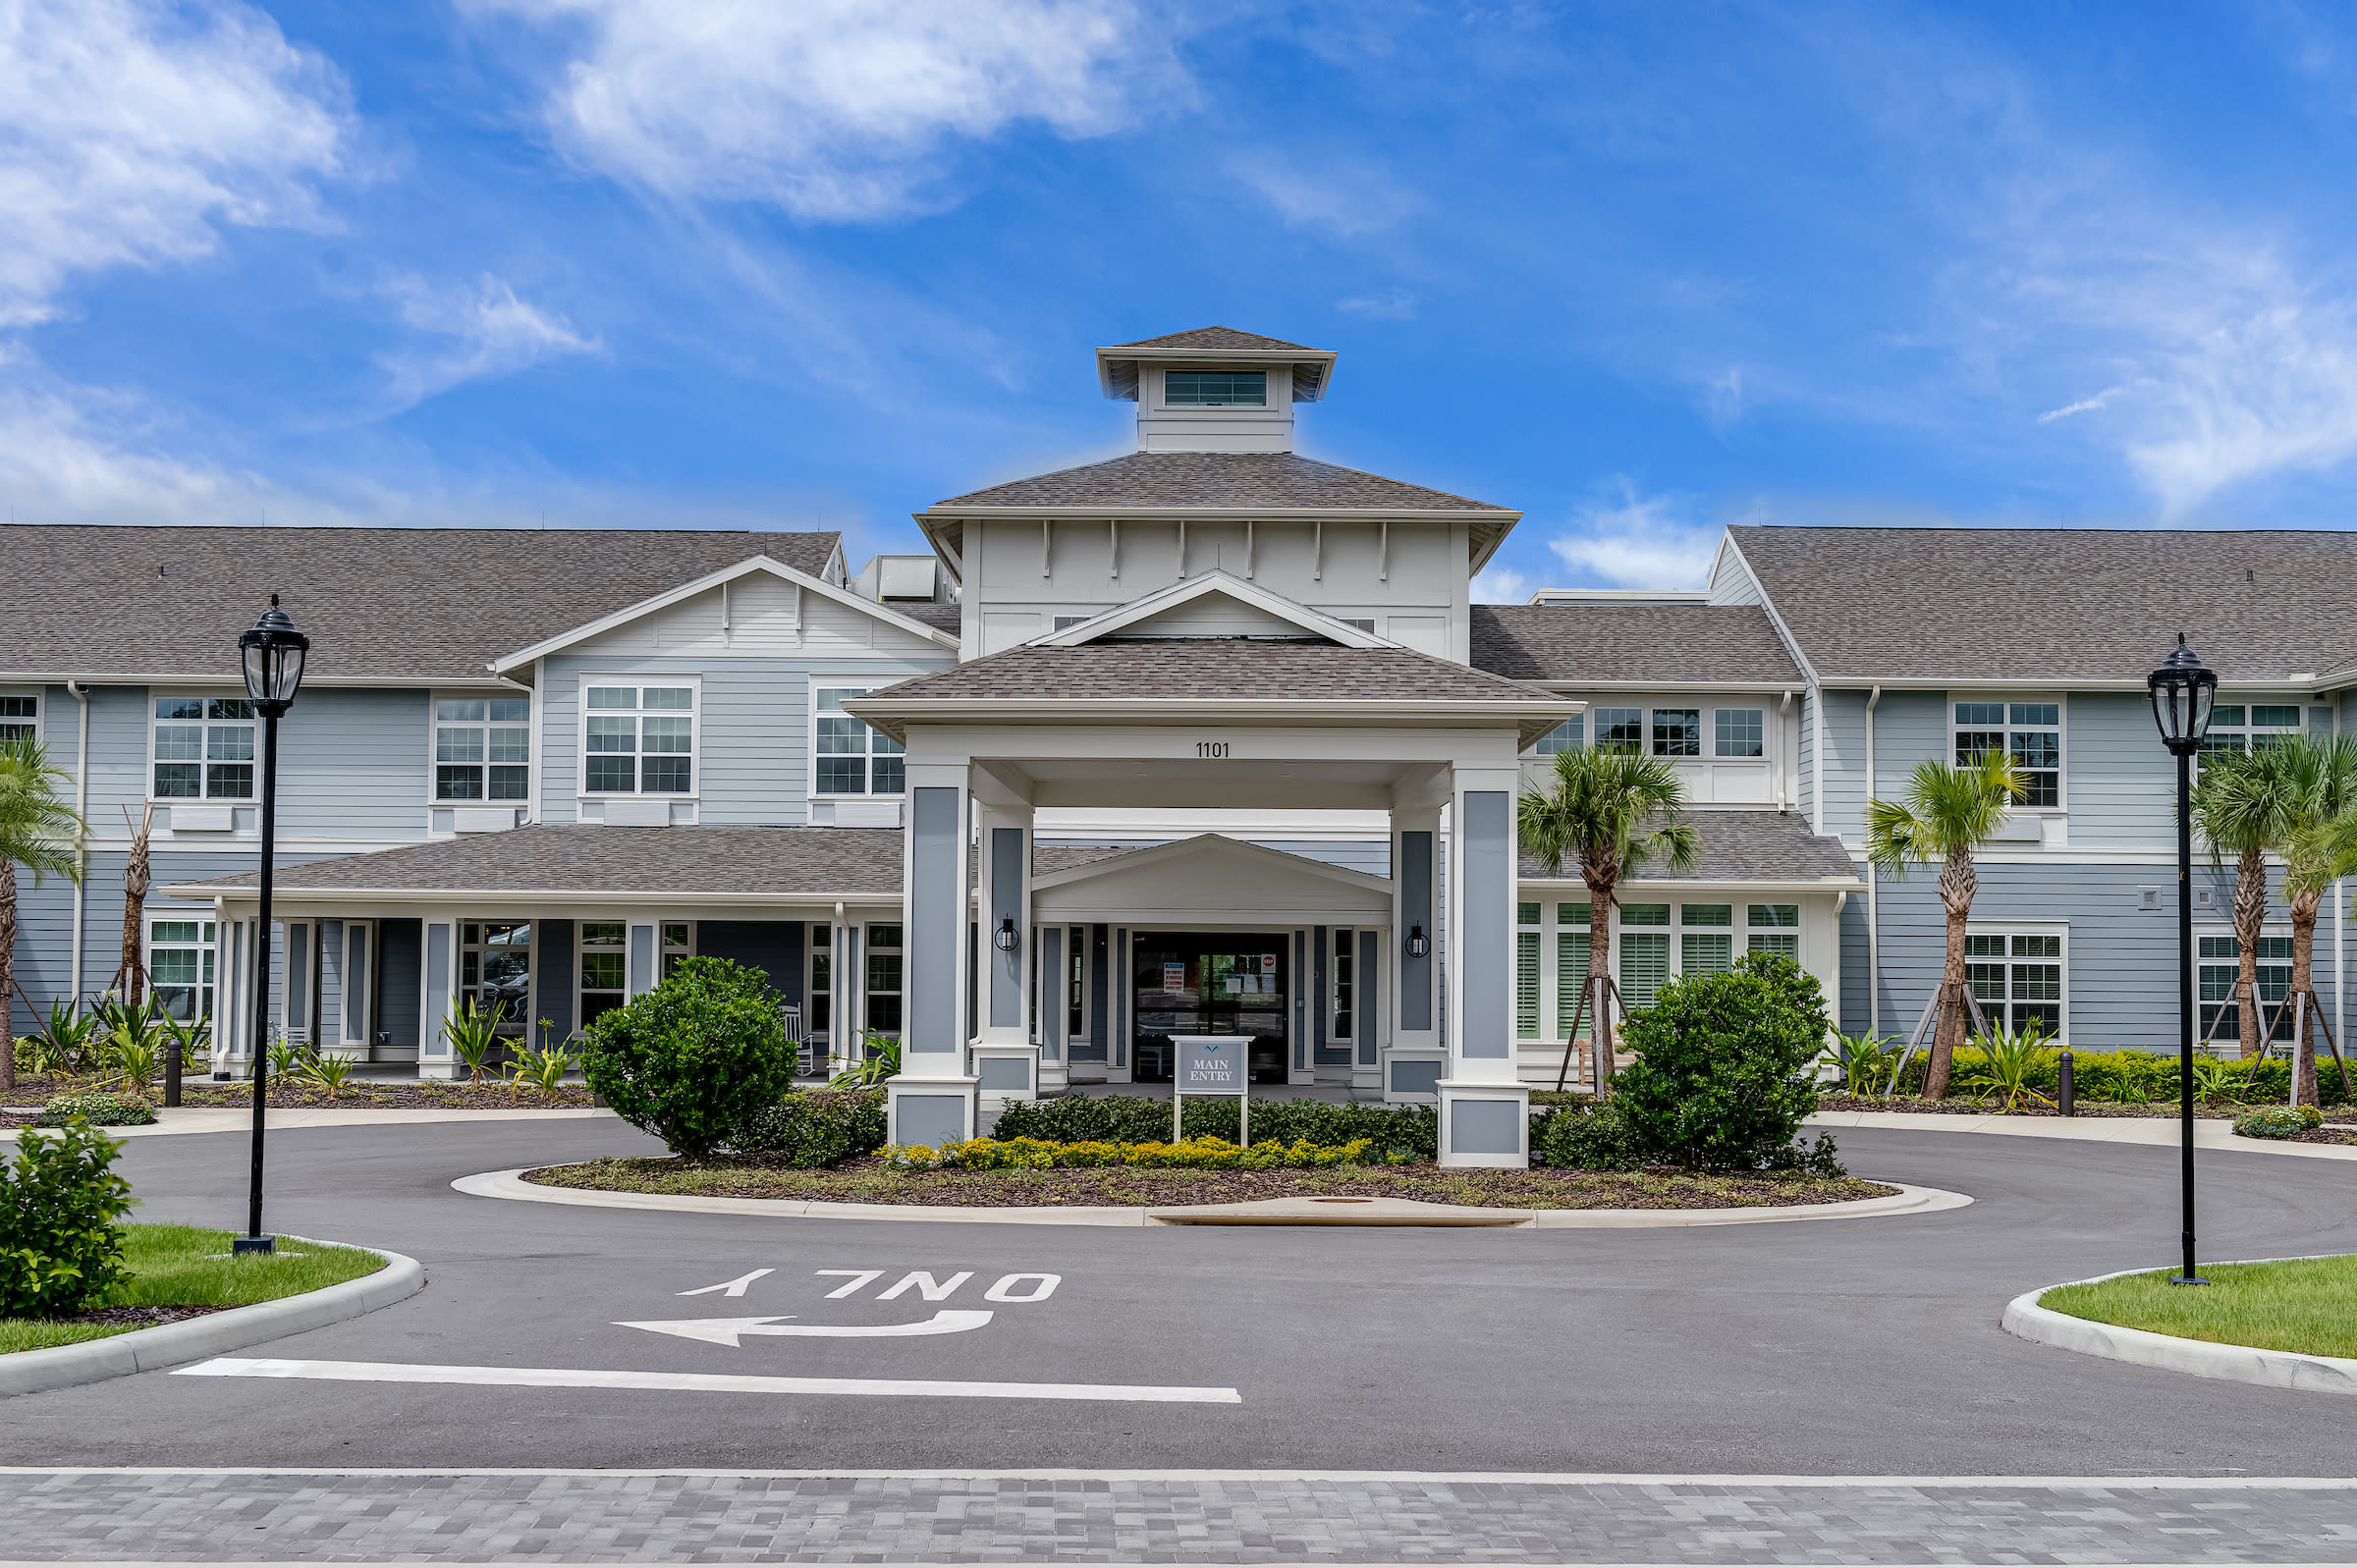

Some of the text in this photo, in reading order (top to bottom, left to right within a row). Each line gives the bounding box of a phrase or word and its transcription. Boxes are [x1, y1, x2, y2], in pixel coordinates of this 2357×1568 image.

[1196, 742, 1229, 758] 1101
[1193, 1059, 1229, 1070] MAIN
[1189, 1070, 1233, 1081] ENTRY
[675, 1268, 1063, 1303] ONLY
